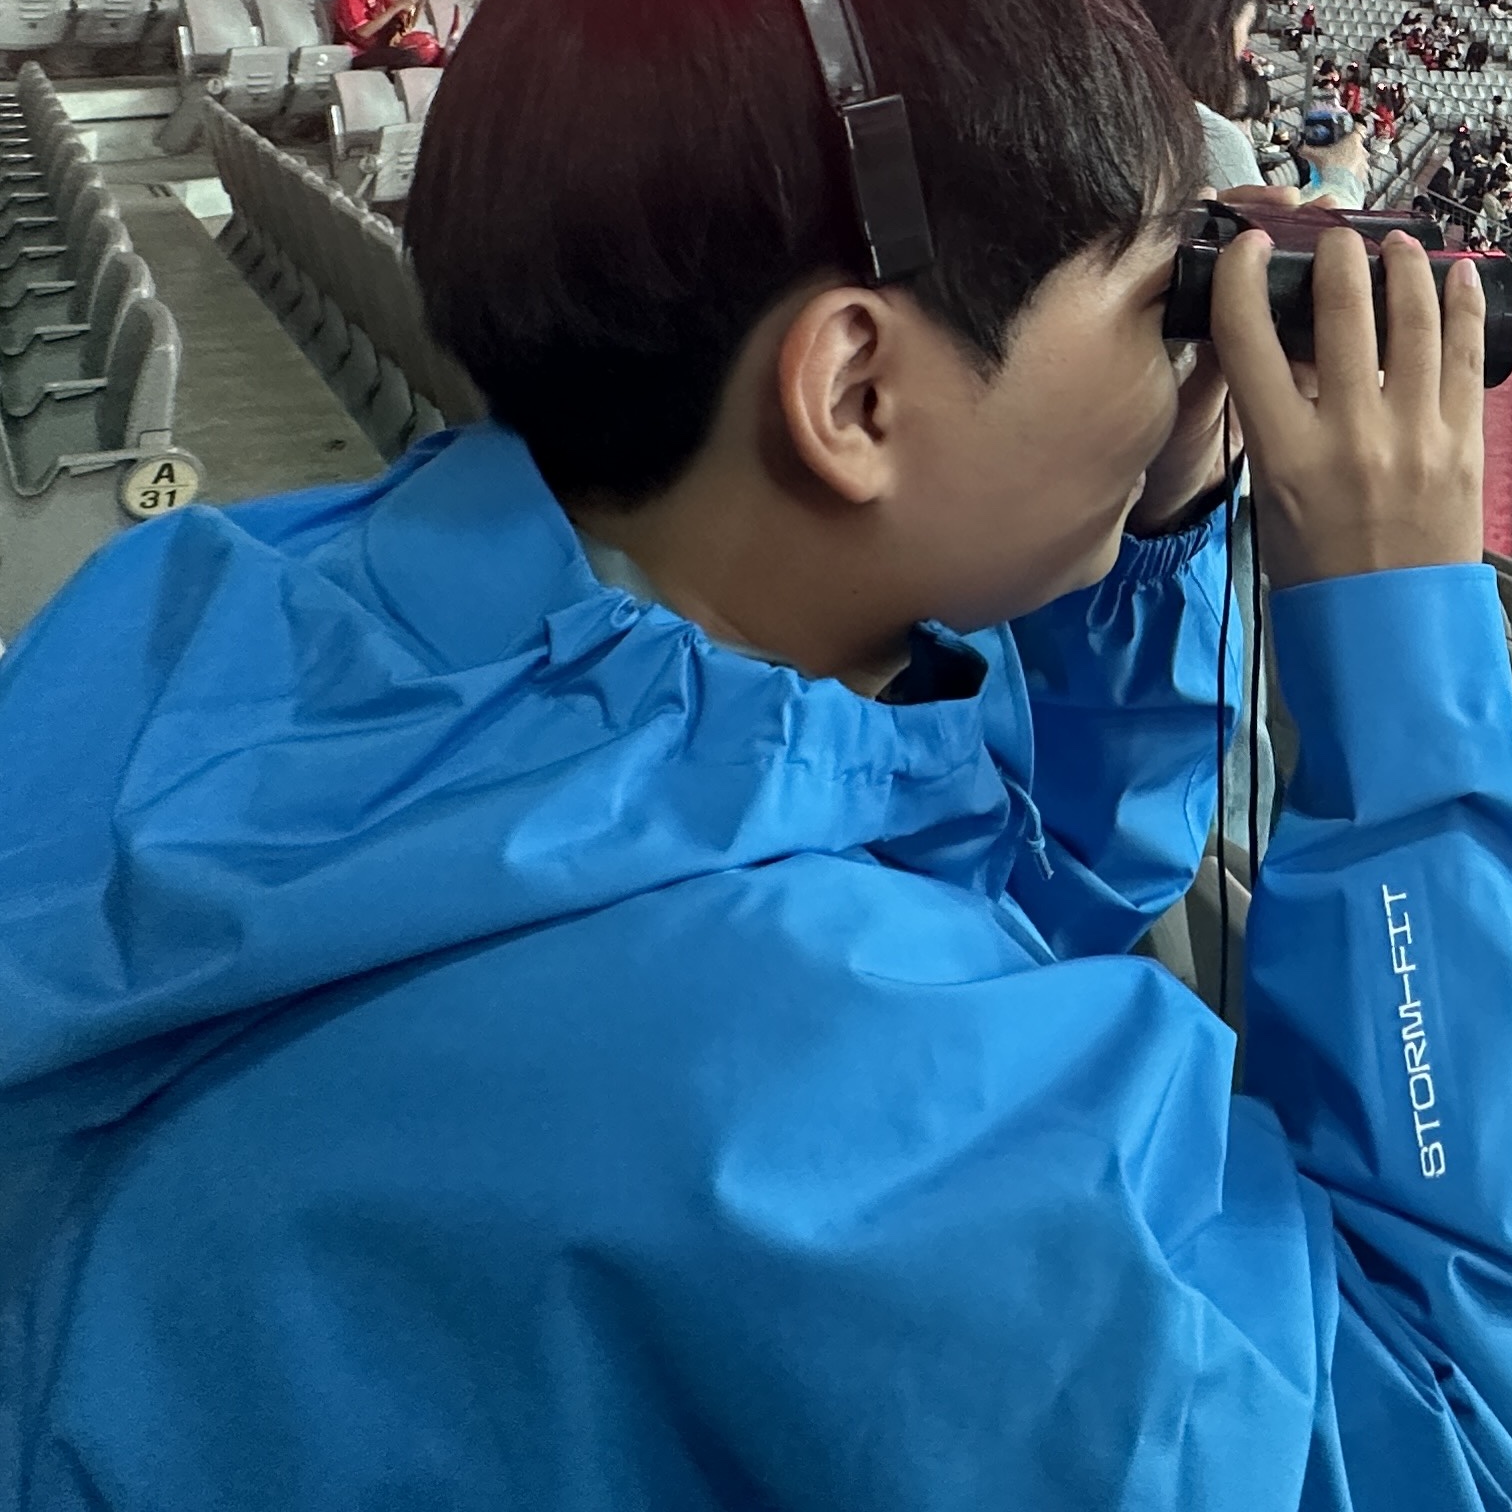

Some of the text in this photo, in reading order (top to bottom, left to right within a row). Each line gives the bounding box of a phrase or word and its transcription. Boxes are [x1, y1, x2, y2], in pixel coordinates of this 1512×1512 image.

[152, 462, 176, 484] A
[139, 489, 177, 509] 31
[1382, 884, 1446, 1178] STORM-FIT
